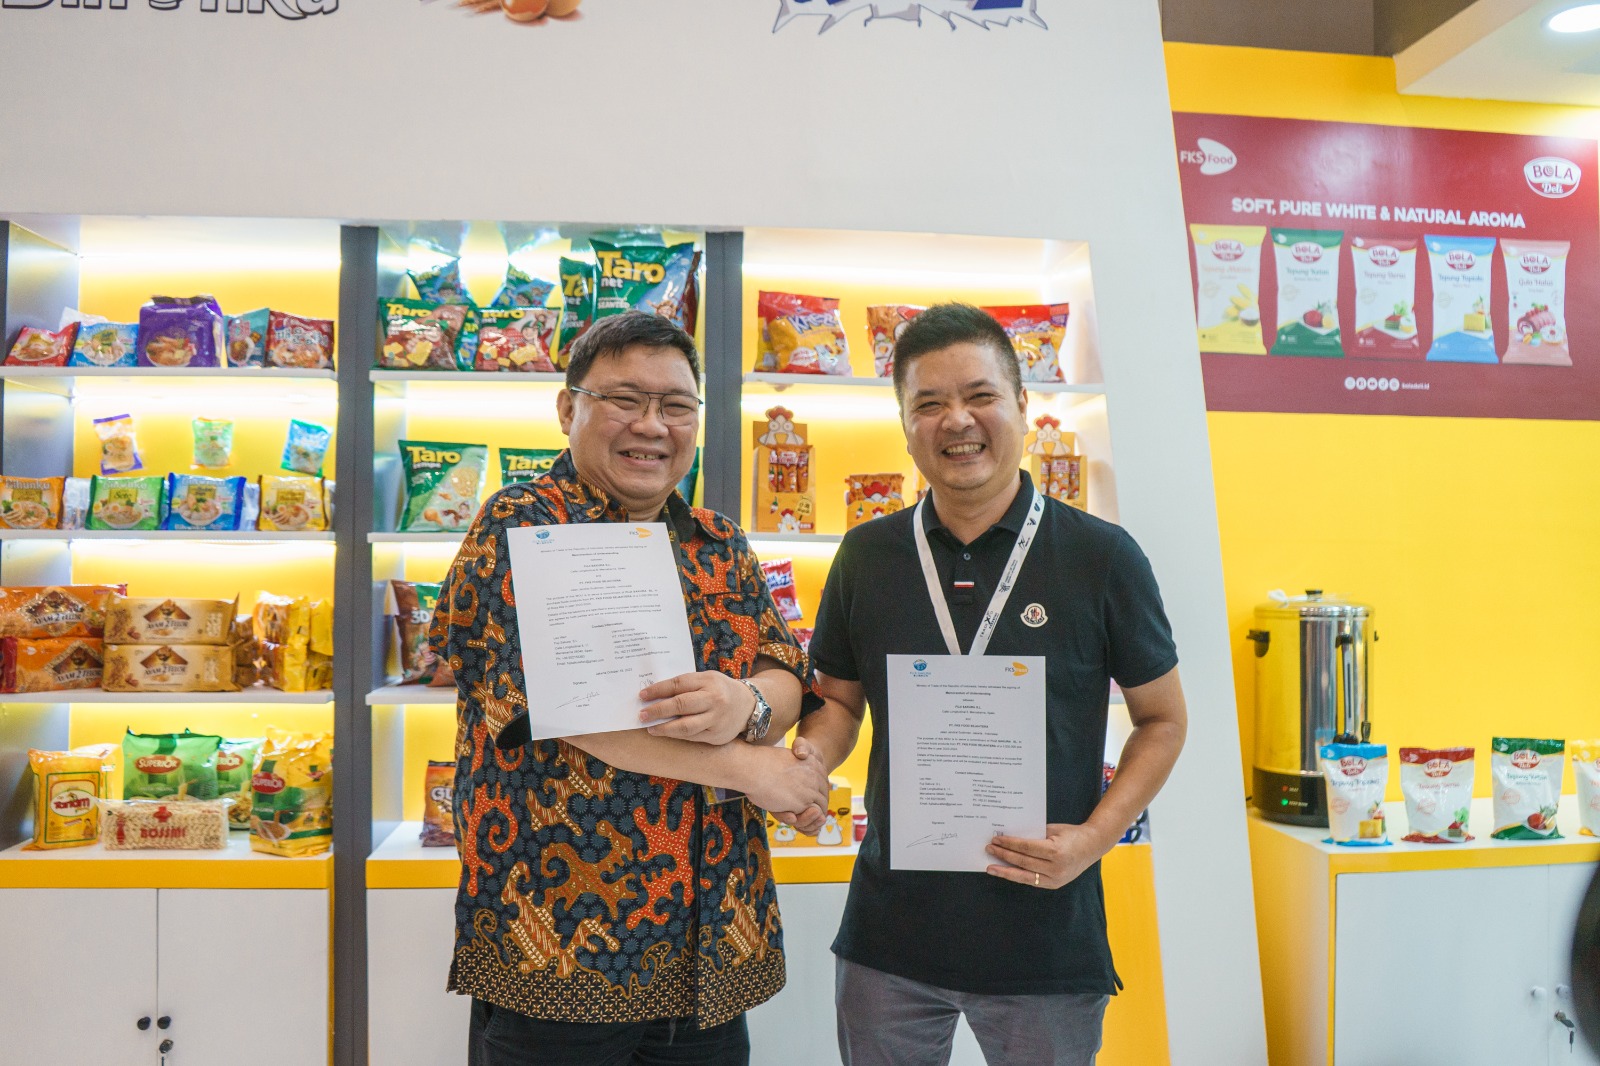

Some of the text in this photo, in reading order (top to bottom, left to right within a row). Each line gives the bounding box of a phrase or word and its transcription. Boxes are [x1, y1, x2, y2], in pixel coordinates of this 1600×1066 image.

[1180, 150, 1204, 163] FKS
[1532, 165, 1573, 181] BOLA
[1541, 182, 1564, 194] Deli
[1231, 197, 1526, 229] SOFT, PURE WHITE & NATURAL AROMA
[1215, 240, 1242, 252] BOLA
[1295, 246, 1320, 254] BOLA
[1372, 249, 1397, 258] BOLA
[1449, 253, 1473, 262] BOLA
[1523, 255, 1549, 265] BOLA
[597, 251, 666, 284] Taro
[601, 278, 623, 288] net
[386, 303, 432, 317] Taro
[406, 446, 461, 464] Taro
[138, 755, 178, 768] SUPERIOR
[1340, 757, 1364, 767] BOLA
[1513, 752, 1538, 760] BOLA
[1426, 761, 1450, 769] BOLA
